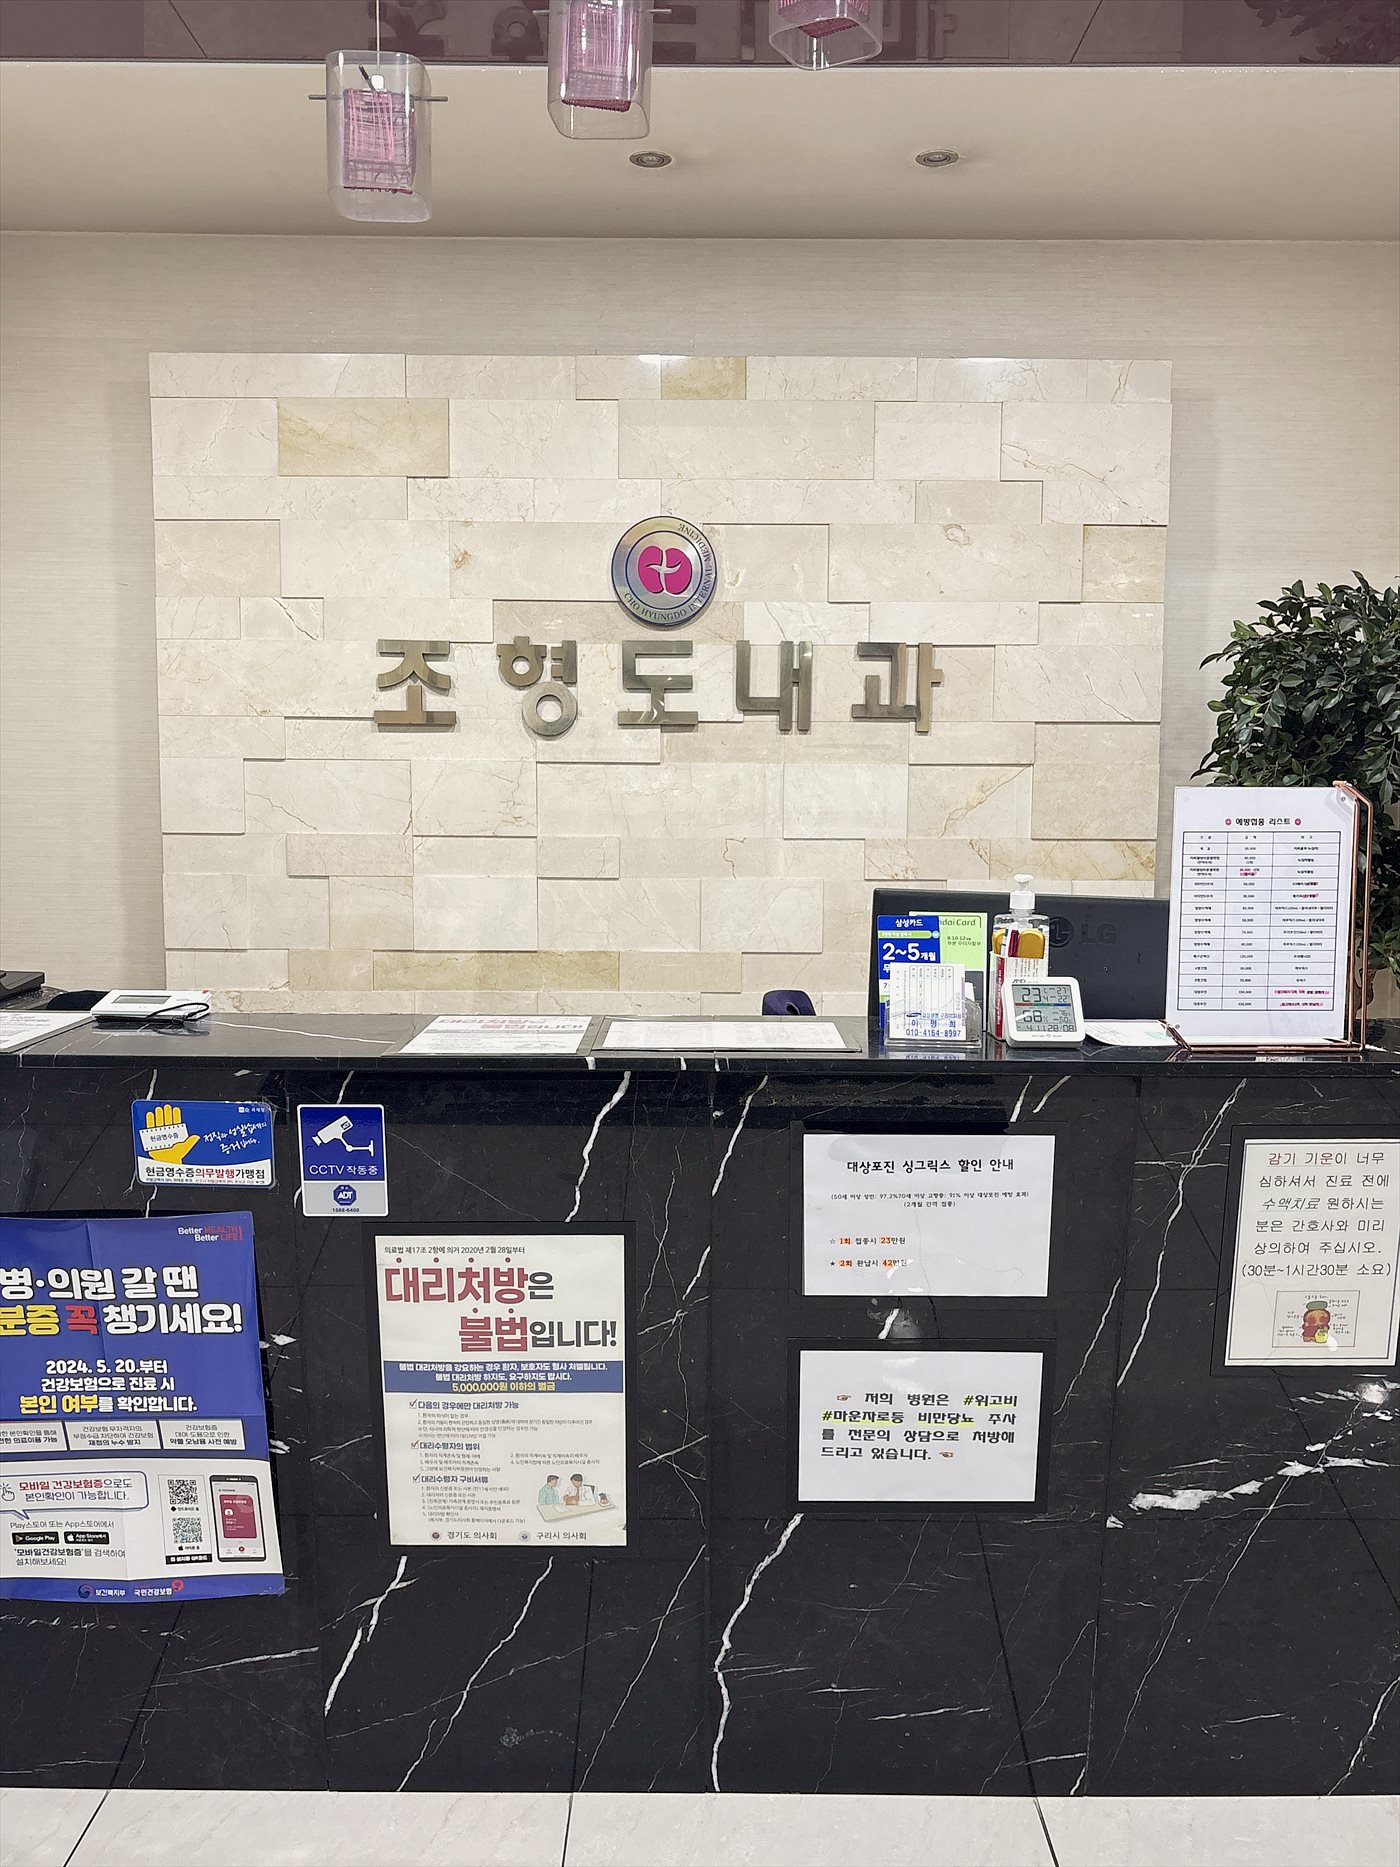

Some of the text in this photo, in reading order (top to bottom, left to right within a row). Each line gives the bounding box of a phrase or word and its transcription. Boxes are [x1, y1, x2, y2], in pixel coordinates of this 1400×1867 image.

[624, 523, 713, 620] CHO HYUNGDO INTERNAL MEDICINE
[373, 635, 944, 737] 조형도내과
[1236, 817, 1291, 827] 예방접종 리스트
[895, 918, 924, 928] 삼성카드
[1080, 923, 1118, 945] LG
[882, 942, 937, 961] 2~5개월
[150, 1132, 179, 1143] 현금영수증
[1268, 1152, 1385, 1166] 감기 기운이 너무
[309, 1164, 379, 1176] CCTV 작동중
[847, 1158, 1014, 1174] 대상포진 싱그릭스 할인 안내
[1259, 1174, 1390, 1188] 심하셔서 진료 전에
[337, 1191, 353, 1199] ADT
[1262, 1197, 1385, 1211] 수액치료 원하시는
[178, 1225, 238, 1235] Better HEALTH
[1255, 1219, 1386, 1233] 분은 간호사와 미리
[194, 1233, 238, 1242] Better LIFE
[840, 1236, 906, 1245] 1회 접종시 23만원
[384, 1246, 404, 1254] 의료법
[405, 1246, 427, 1254] 제17조
[446, 1246, 460, 1254] 의거
[461, 1246, 484, 1254] 2020년
[485, 1246, 496, 1254] 2월
[497, 1246, 525, 1254] 28일부터
[1254, 1241, 1382, 1255] 상의하여 주십시오.
[1242, 1262, 1391, 1277] (30분~1시간30분 소요)
[0, 1265, 200, 1300] 병·의원 갈 땐
[384, 1262, 555, 1304] 대리처방은
[65, 1304, 98, 1335] 꼭
[103, 1303, 244, 1335] 챙기세요!
[458, 1314, 617, 1353] 불법입니다!
[46, 1359, 168, 1374] 2024. 5. 20.부터
[415, 1362, 453, 1372] 대리처방을
[454, 1363, 484, 1372] 강요하는
[485, 1363, 501, 1372] 경우
[520, 1362, 551, 1371] 보호자도
[552, 1362, 567, 1371] 형사
[452, 1373, 482, 1382] 대리처방
[483, 1373, 508, 1382] 하지도,
[509, 1372, 547, 1381] 요구하지도
[41, 1377, 175, 1392] 건강보험으로 진료 시
[452, 1382, 556, 1393] 5,000,000원 이하의 벌금
[20, 1395, 198, 1414] 본인 여부를 확인합니다.
[418, 1401, 519, 1410] 다음의 경우에만 대리처방 가능
[865, 1392, 1018, 1407] 저희 병원은 #위고비
[821, 1410, 1017, 1425] #마운자로등 비만당뇨 주사
[821, 1428, 1015, 1444] 를 전문의 상담으로 처방해
[419, 1442, 480, 1450] 대리수령자의 범위
[821, 1446, 932, 1460] 드리고 있습니다.
[19, 1479, 133, 1491] 모바일 건강보험증으로도
[421, 1475, 489, 1484] 대리수령자 구비서류
[25, 1490, 130, 1502] 본인확인이 가능합니다.
[10, 1520, 115, 1529] Play스토어 또는 App스토어에서
[447, 1531, 498, 1540] 경기도 의사회
[536, 1531, 588, 1540] 구리시 의사회
[94, 1548, 126, 1558] 검색하여
[16, 1558, 67, 1566] 설치해보세요!
[95, 1589, 126, 1597] 보건복지부
